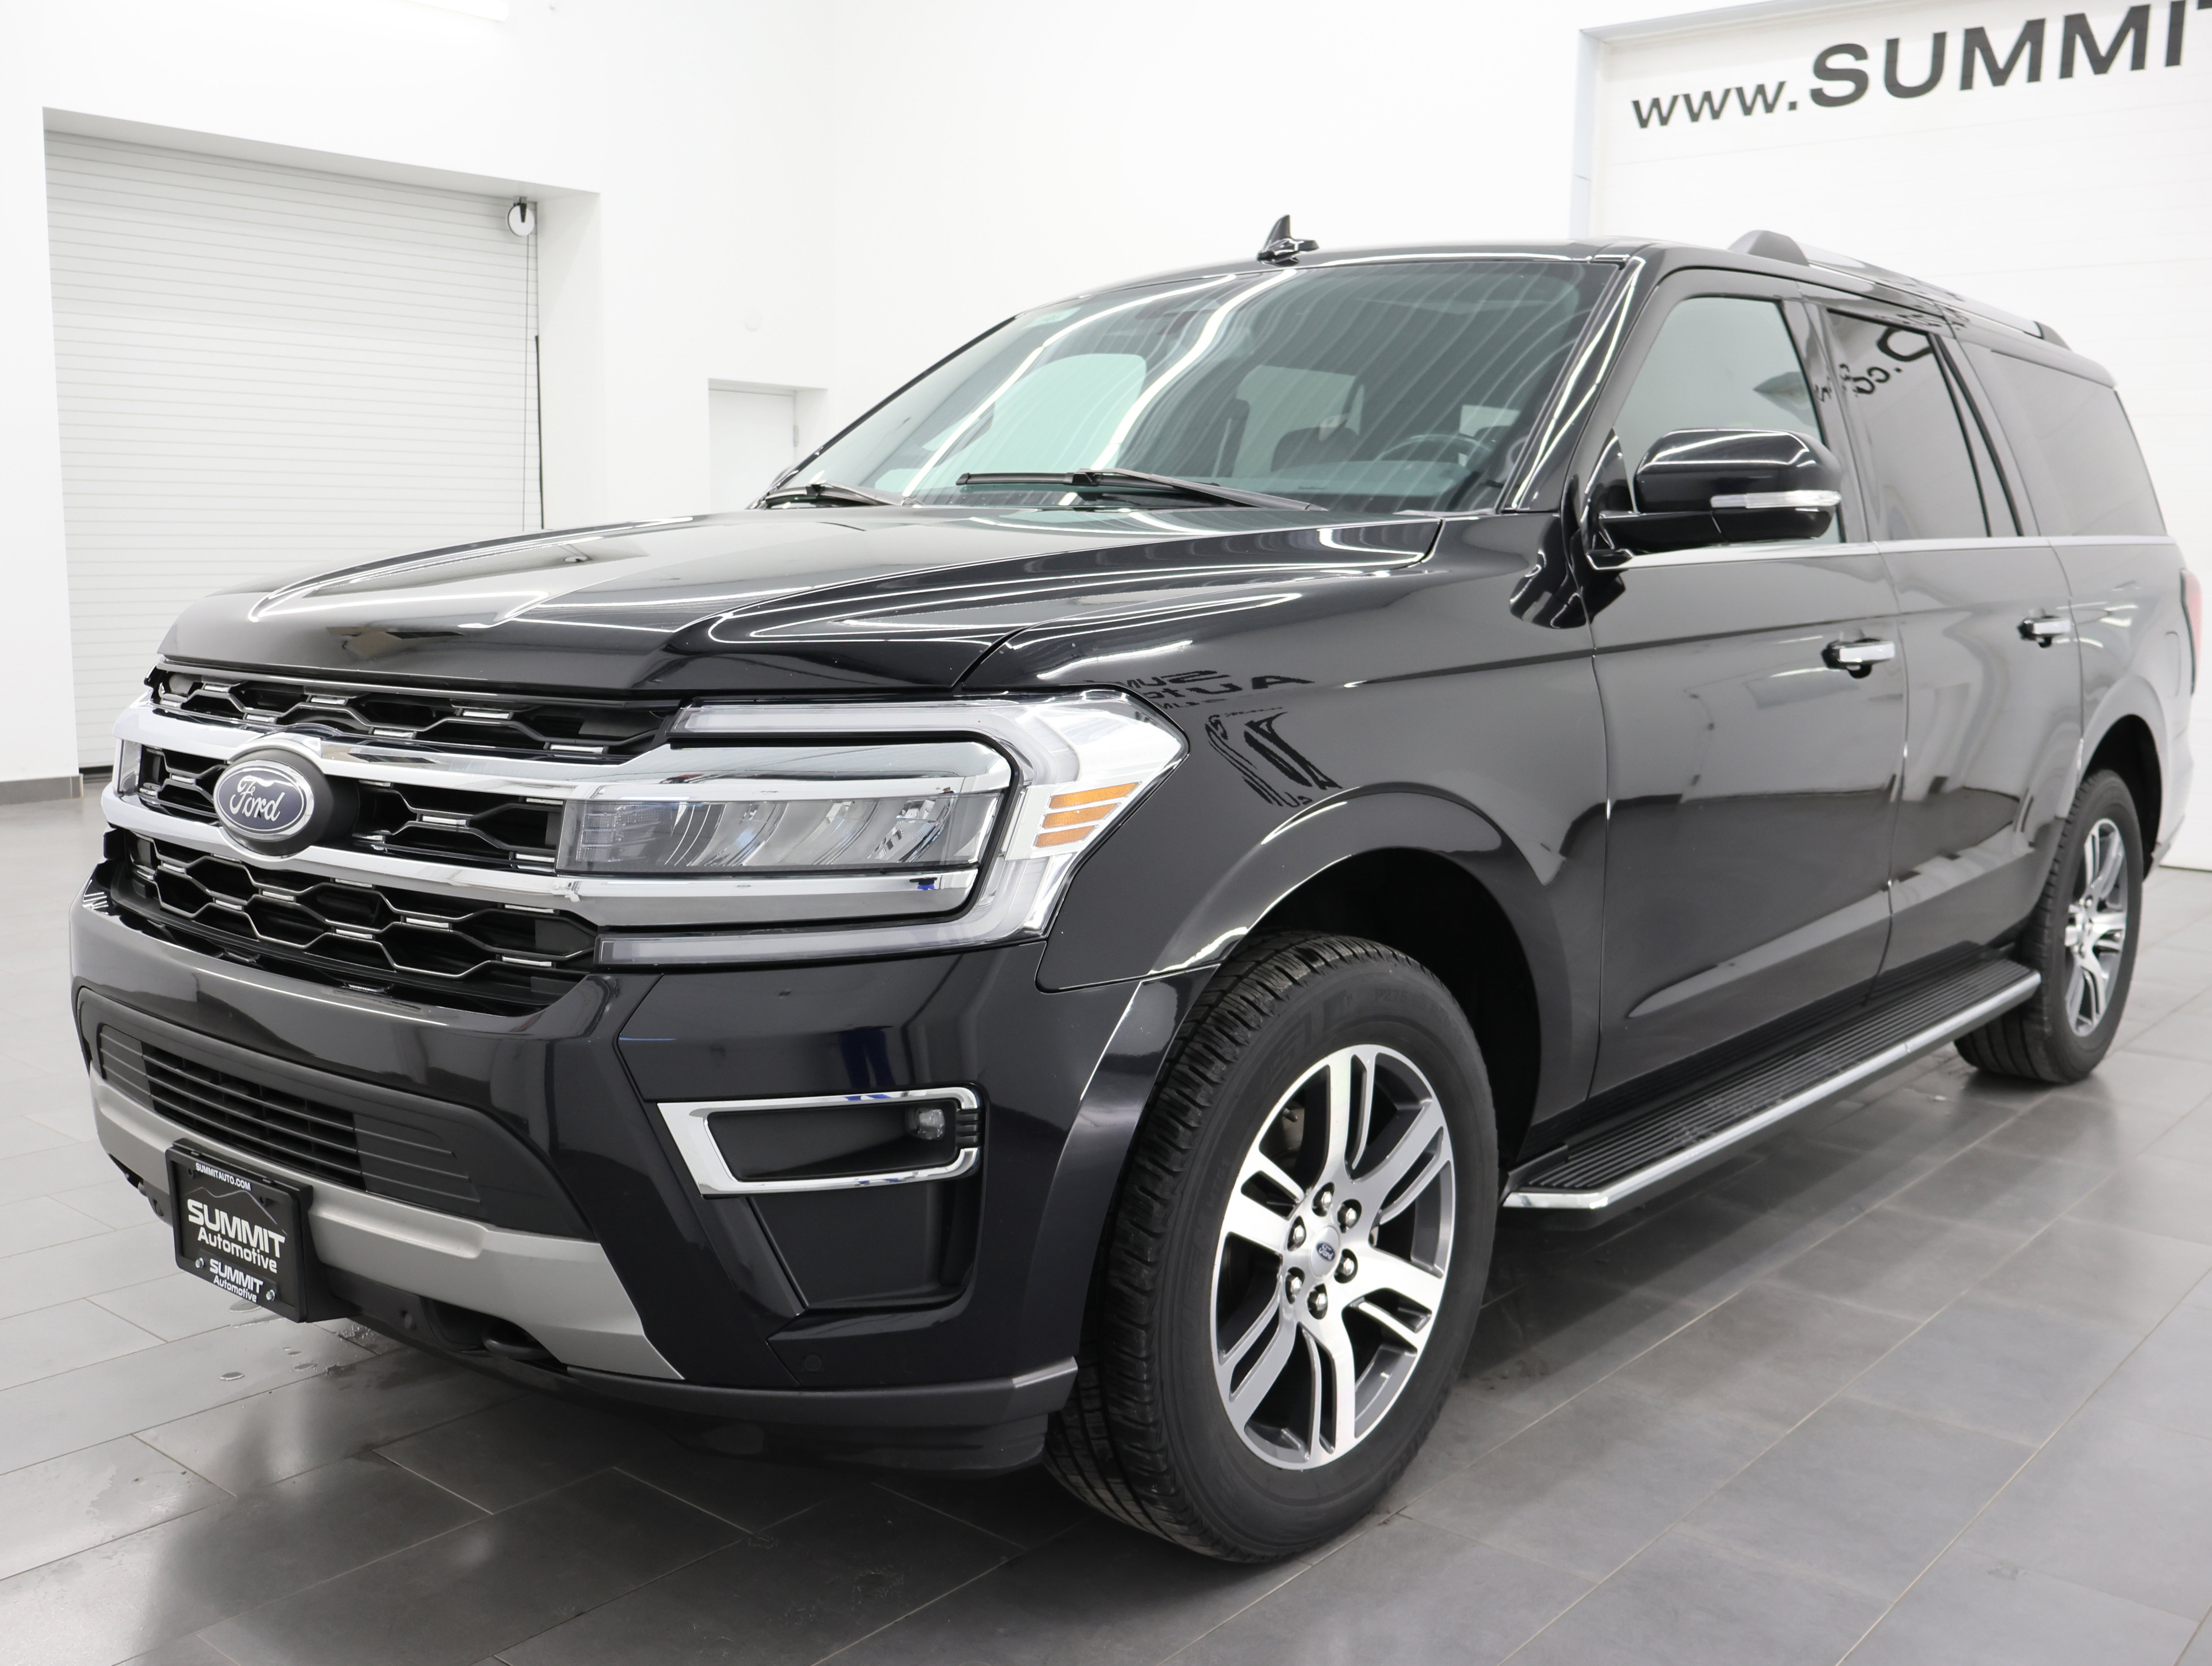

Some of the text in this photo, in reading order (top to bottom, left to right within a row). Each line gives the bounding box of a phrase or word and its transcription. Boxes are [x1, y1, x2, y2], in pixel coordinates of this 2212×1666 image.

[1632, 0, 2212, 129] www.SUMMI
[229, 774, 285, 821] Ford
[196, 1162, 251, 1191] SUMMITAUTO.COM
[187, 1199, 285, 1258] SUMMIT
[197, 1227, 277, 1273] Automotive
[1318, 1244, 1333, 1260] Ford
[210, 1258, 263, 1293] SUMMIT
[213, 1275, 257, 1303] Automotive
